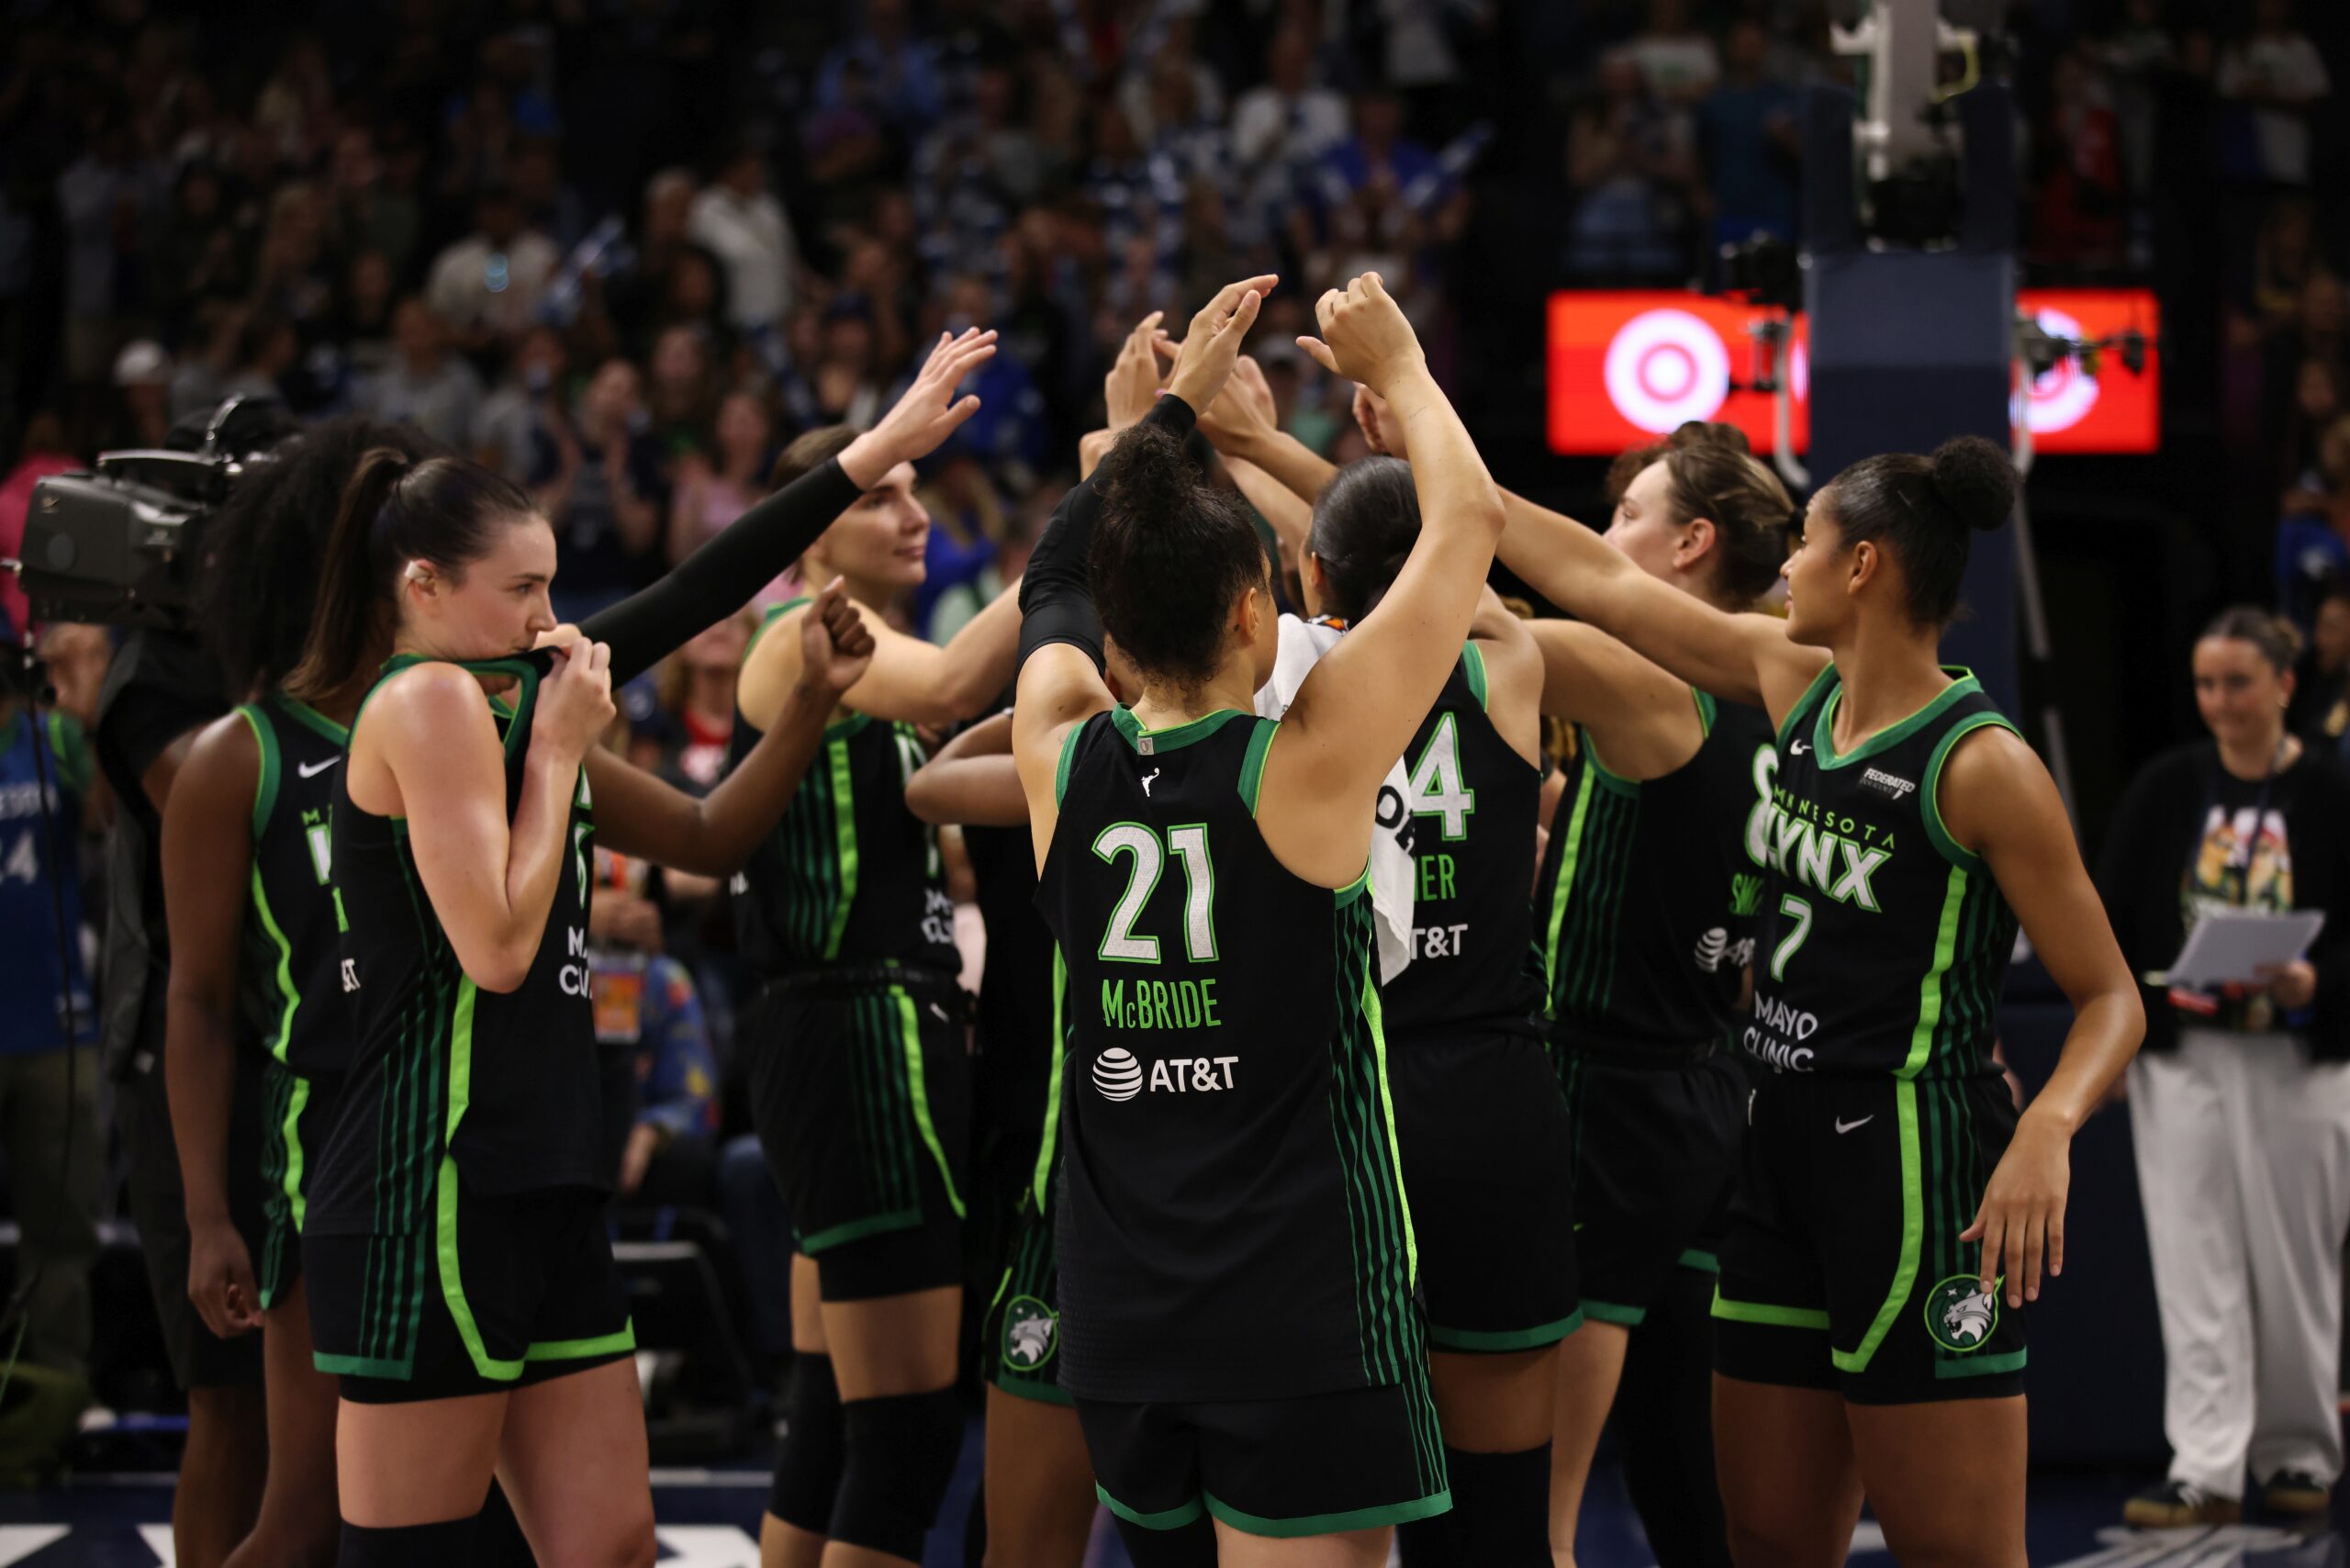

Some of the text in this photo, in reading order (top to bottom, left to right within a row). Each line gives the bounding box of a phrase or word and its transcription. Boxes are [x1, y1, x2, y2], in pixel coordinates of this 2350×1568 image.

[1863, 767, 1916, 792] FEDERATED
[1773, 783, 1896, 850] MNNESOTA
[1765, 801, 1893, 913] LYNX
[1091, 822, 1219, 964] 21
[1771, 893, 1813, 982] 7
[1754, 990, 1818, 1040] MAYO
[1150, 1056, 1239, 1092] AT&T
[1743, 1025, 1815, 1073] CLINIC
